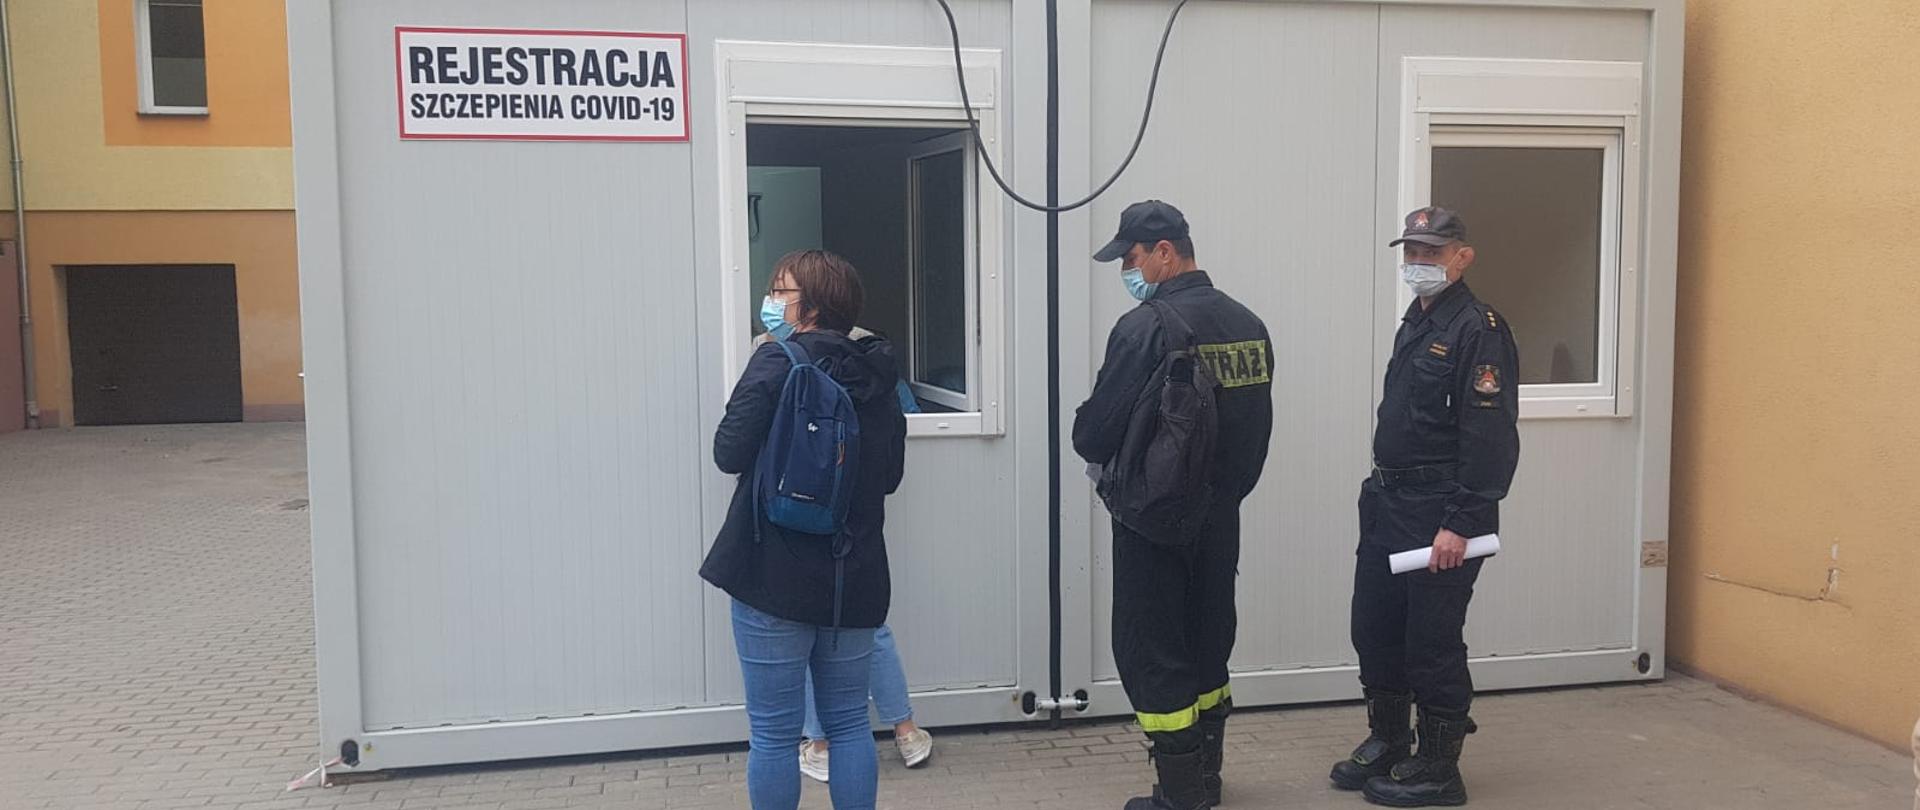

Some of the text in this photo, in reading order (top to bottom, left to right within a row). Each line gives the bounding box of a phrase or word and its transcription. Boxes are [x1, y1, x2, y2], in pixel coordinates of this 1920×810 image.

[409, 46, 675, 88] REJESTRACJA
[410, 93, 675, 121] SZCZEPIENIA COVID-19
